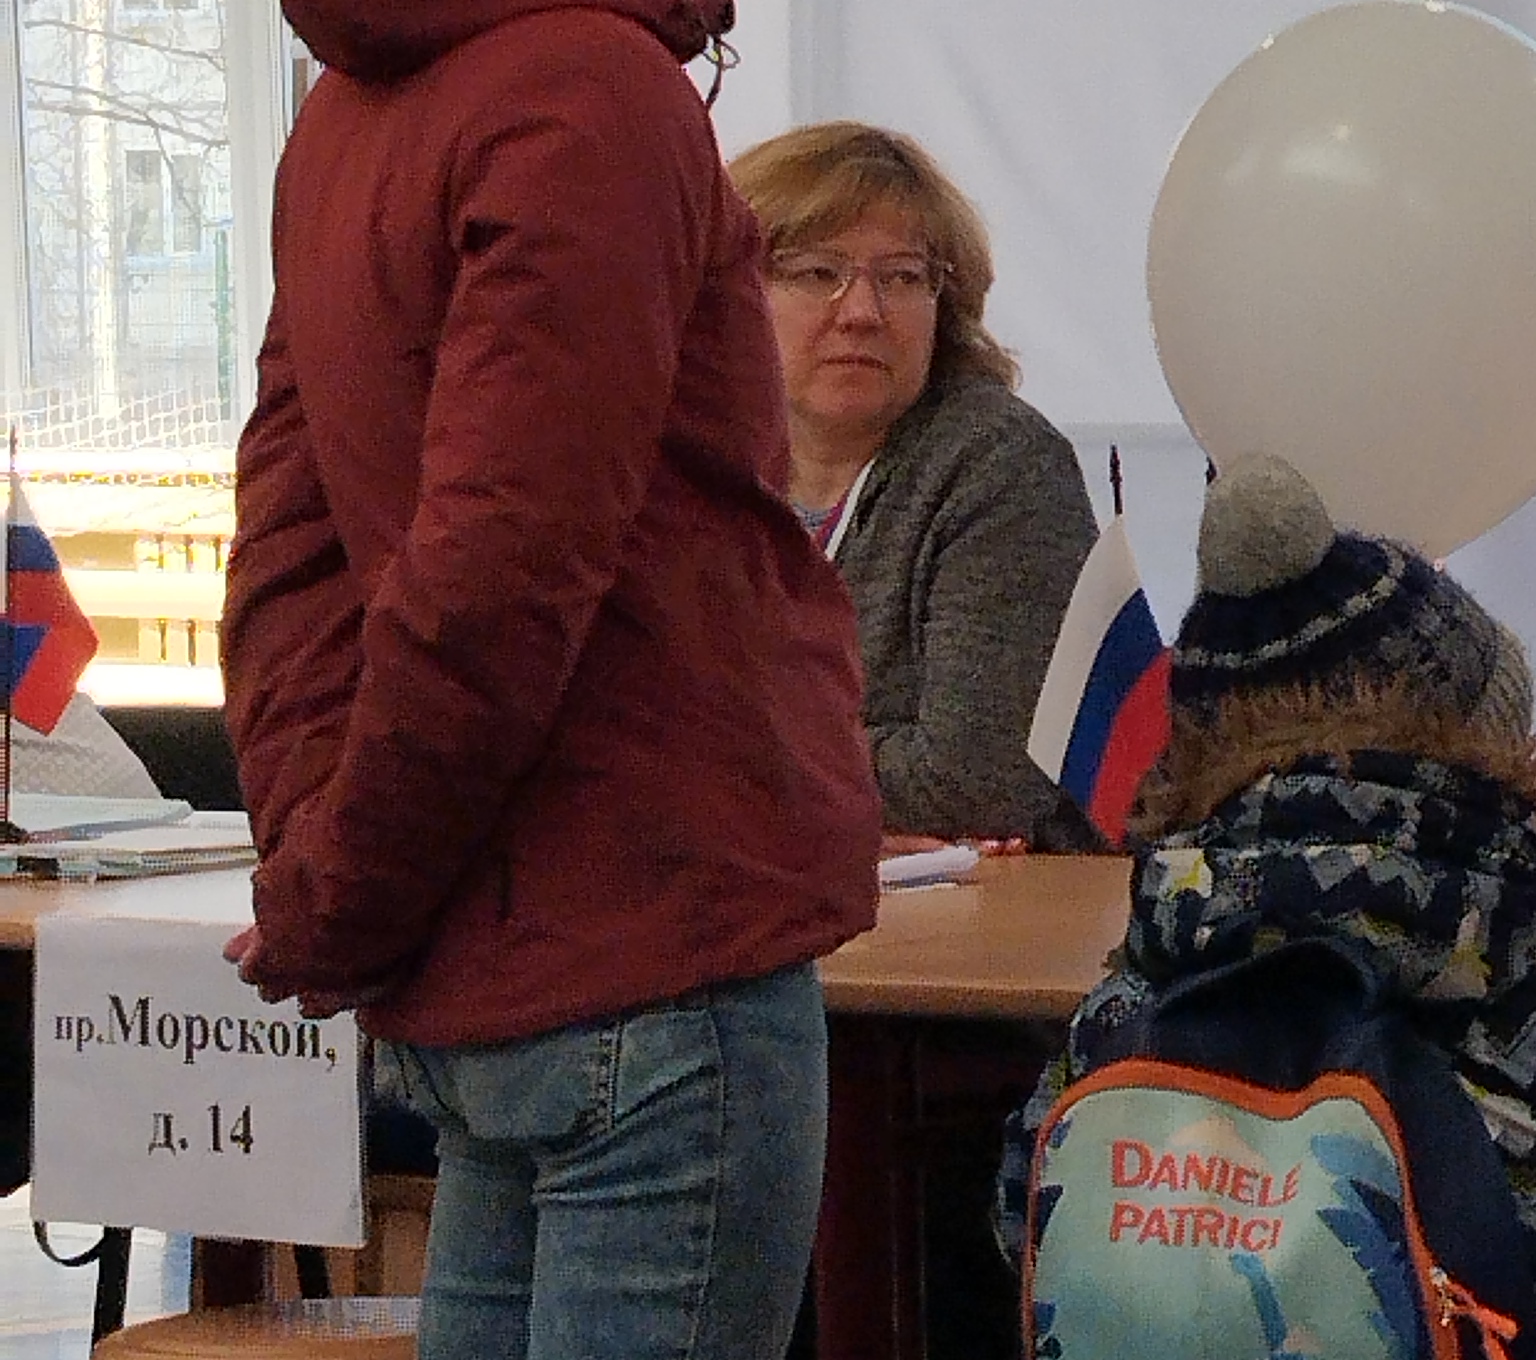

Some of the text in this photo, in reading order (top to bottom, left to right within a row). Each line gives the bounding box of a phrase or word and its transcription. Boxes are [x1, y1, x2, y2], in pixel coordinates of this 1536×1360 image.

[148, 1102, 254, 1155] д. 14
[1109, 1199, 1284, 1252] PATRICI
